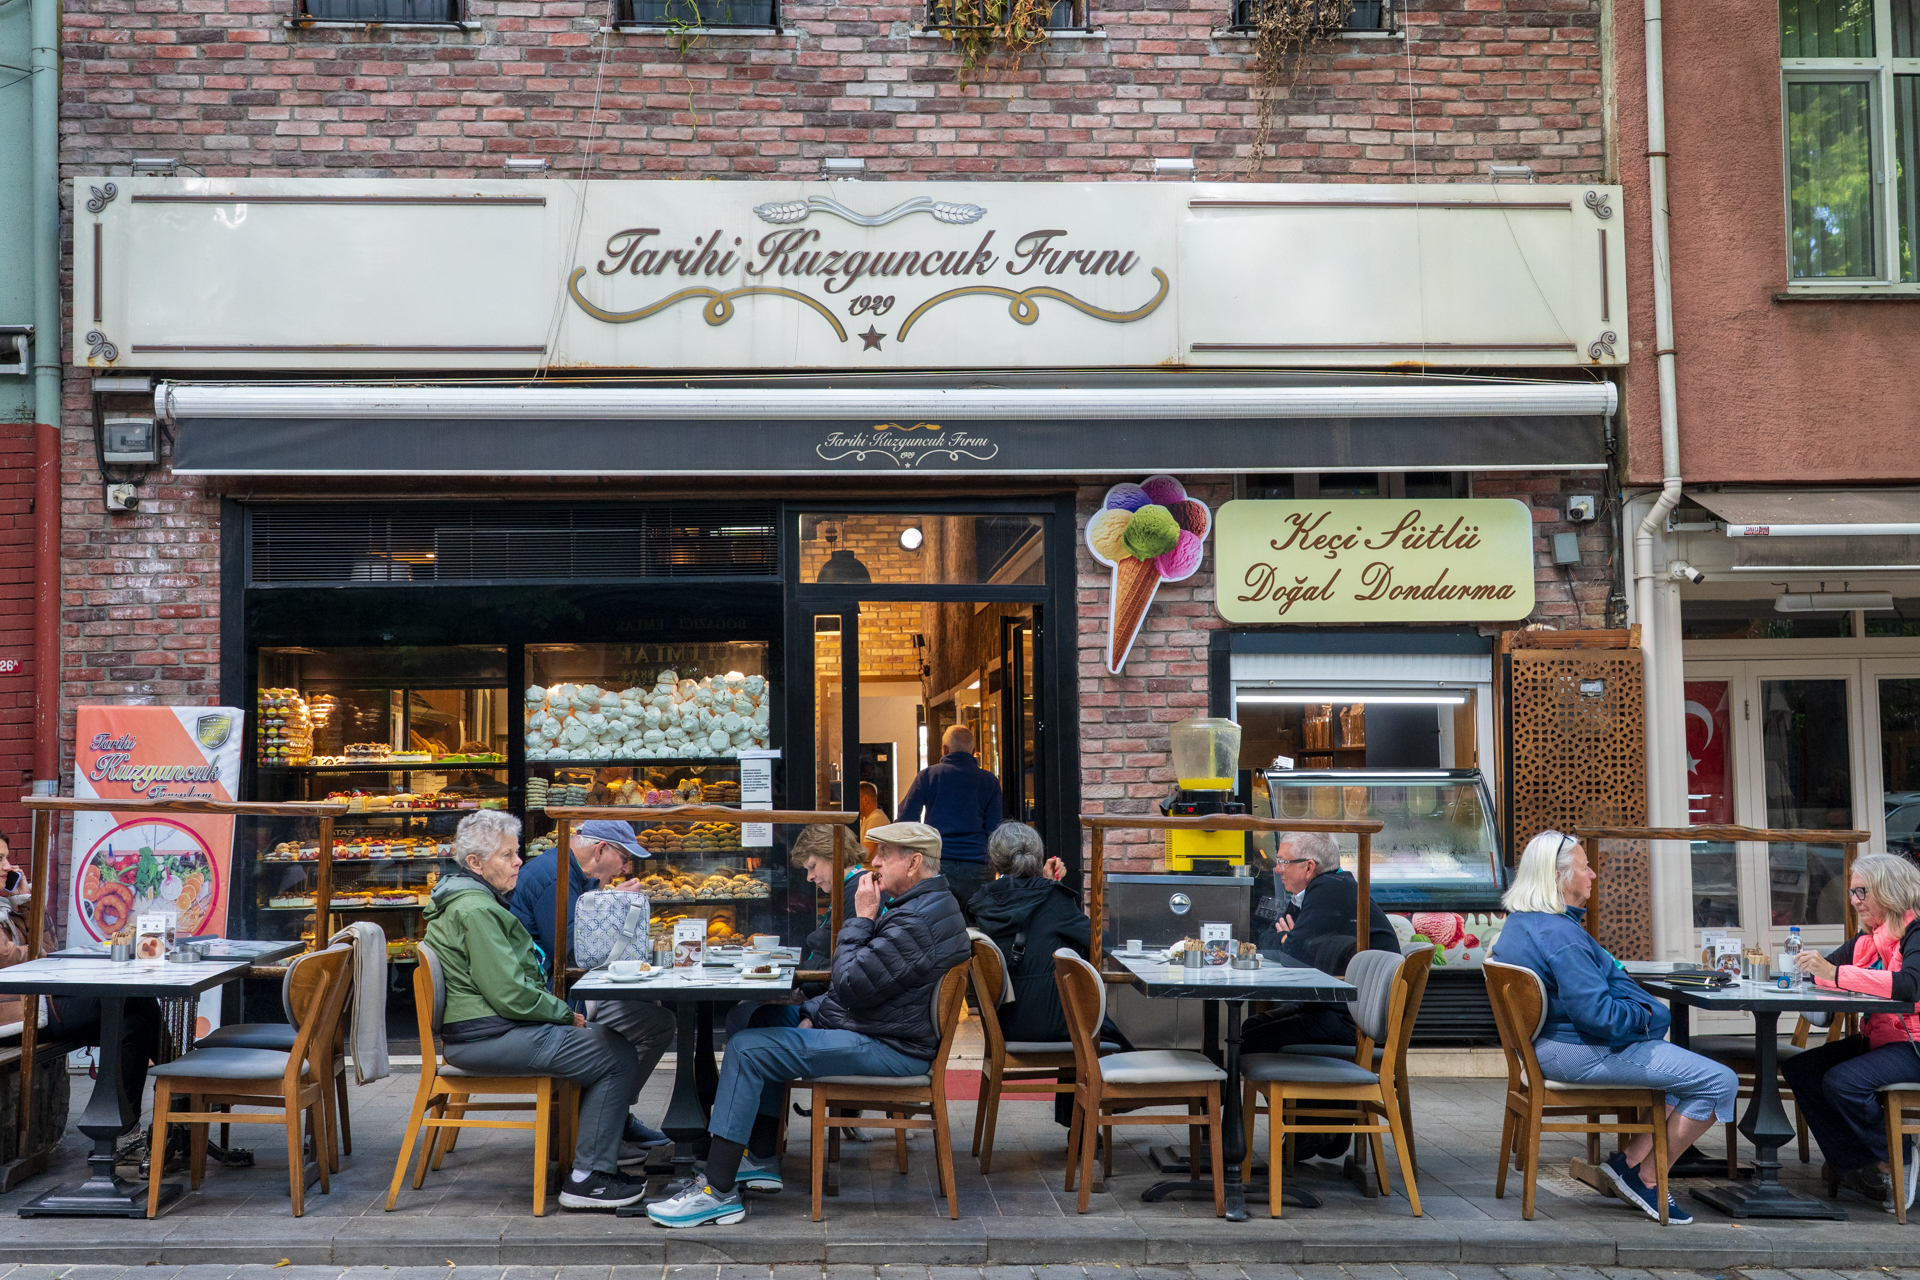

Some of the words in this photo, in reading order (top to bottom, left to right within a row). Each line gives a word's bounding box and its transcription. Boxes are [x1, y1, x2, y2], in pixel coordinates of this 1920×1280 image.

[597, 228, 742, 277] Tarihi
[745, 228, 999, 295] Kuzguncuk
[847, 294, 896, 317] 1929
[824, 432, 869, 447] Tarihi
[869, 432, 946, 452] Kuzguncuk
[1270, 510, 1363, 560] Keçi
[1364, 509, 1482, 551] Sütlü
[1237, 562, 1342, 616] Doğal
[1354, 561, 1517, 602] Dondurma
[90, 733, 137, 750] Tarihi
[90, 753, 222, 793] Kuzguncuk
